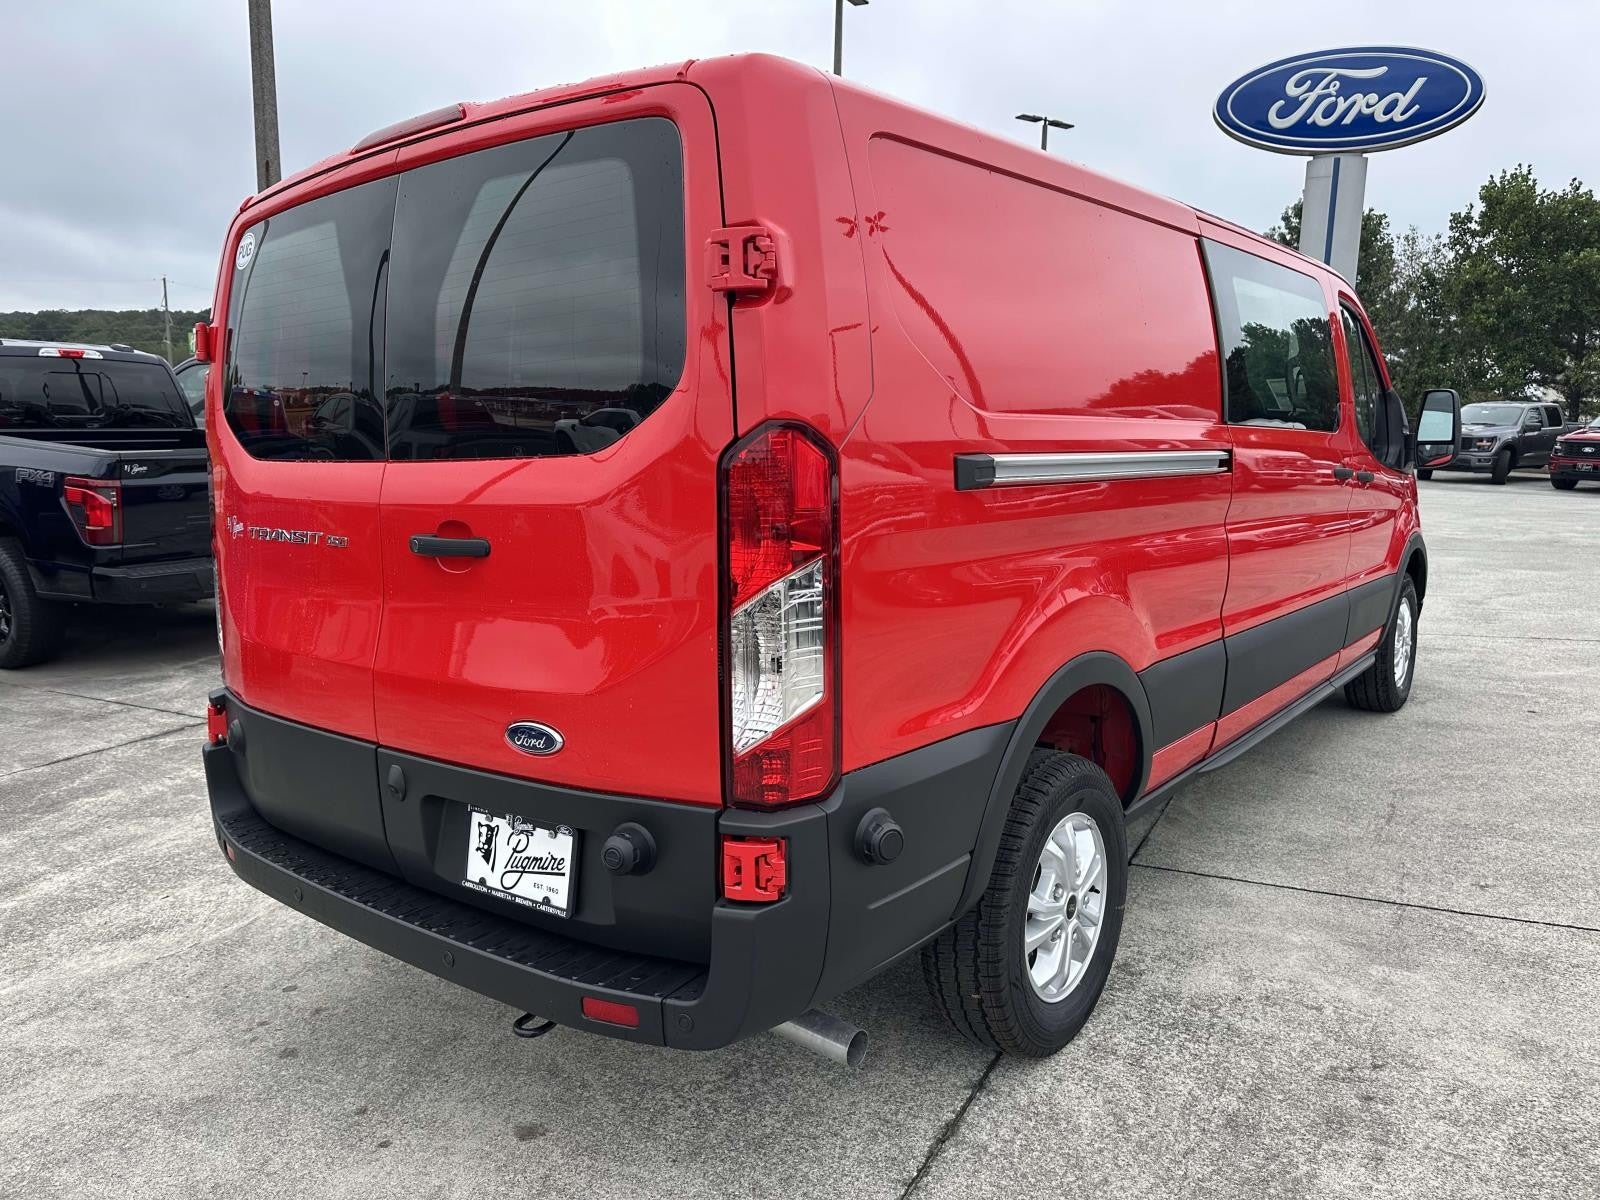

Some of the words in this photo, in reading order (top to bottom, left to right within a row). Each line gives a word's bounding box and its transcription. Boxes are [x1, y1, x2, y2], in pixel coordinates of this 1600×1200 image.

[1267, 65, 1428, 129] Ford
[15, 467, 55, 485] FX4
[247, 526, 323, 545] TRANSIT
[514, 728, 546, 749] Ford
[500, 831, 566, 890] Pugmire
[533, 882, 545, 891] EST.
[546, 884, 559, 895] 1960
